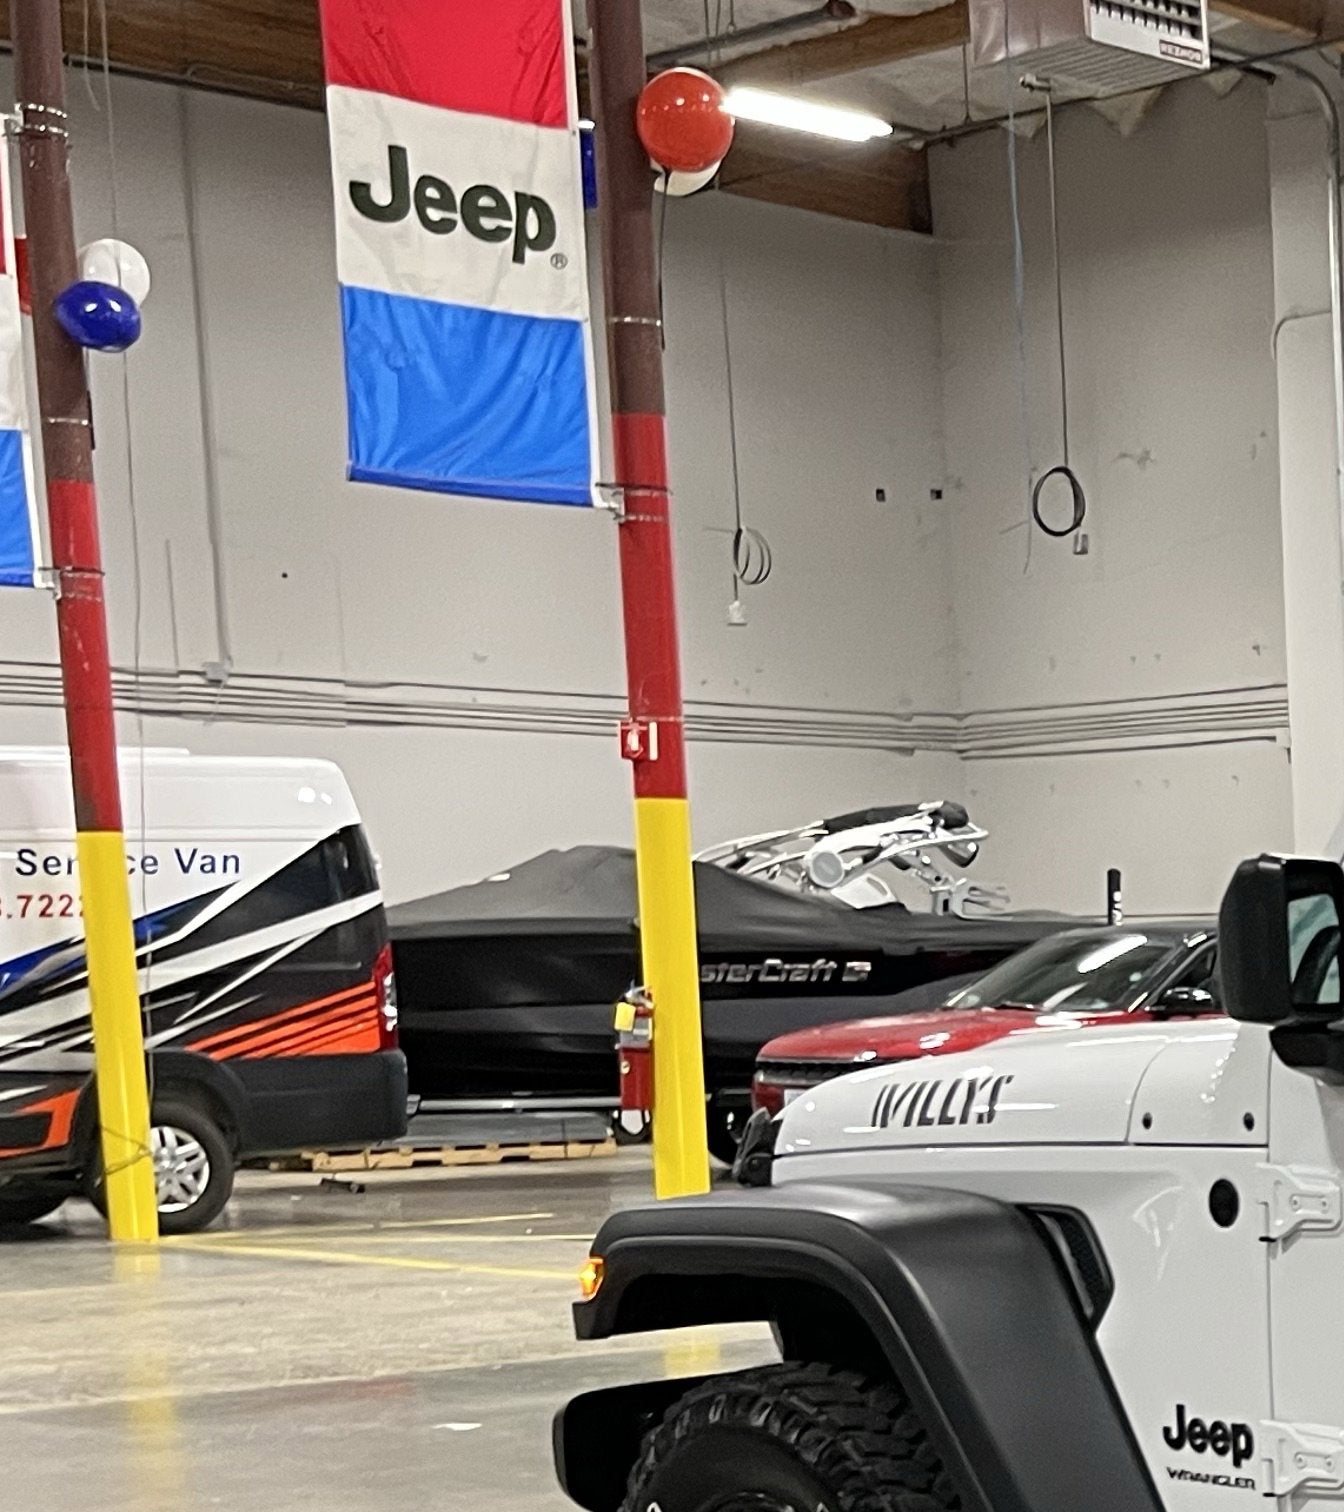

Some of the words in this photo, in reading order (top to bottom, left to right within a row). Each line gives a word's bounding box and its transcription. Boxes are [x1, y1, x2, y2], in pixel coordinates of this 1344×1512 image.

[349, 144, 557, 265] Jeep
[174, 847, 240, 874] Van
[700, 958, 837, 982] sterCraft
[871, 1074, 1014, 1128] WILLYS
[1162, 1403, 1255, 1469] Jeep
[1166, 1466, 1256, 1490] WRANGLER
